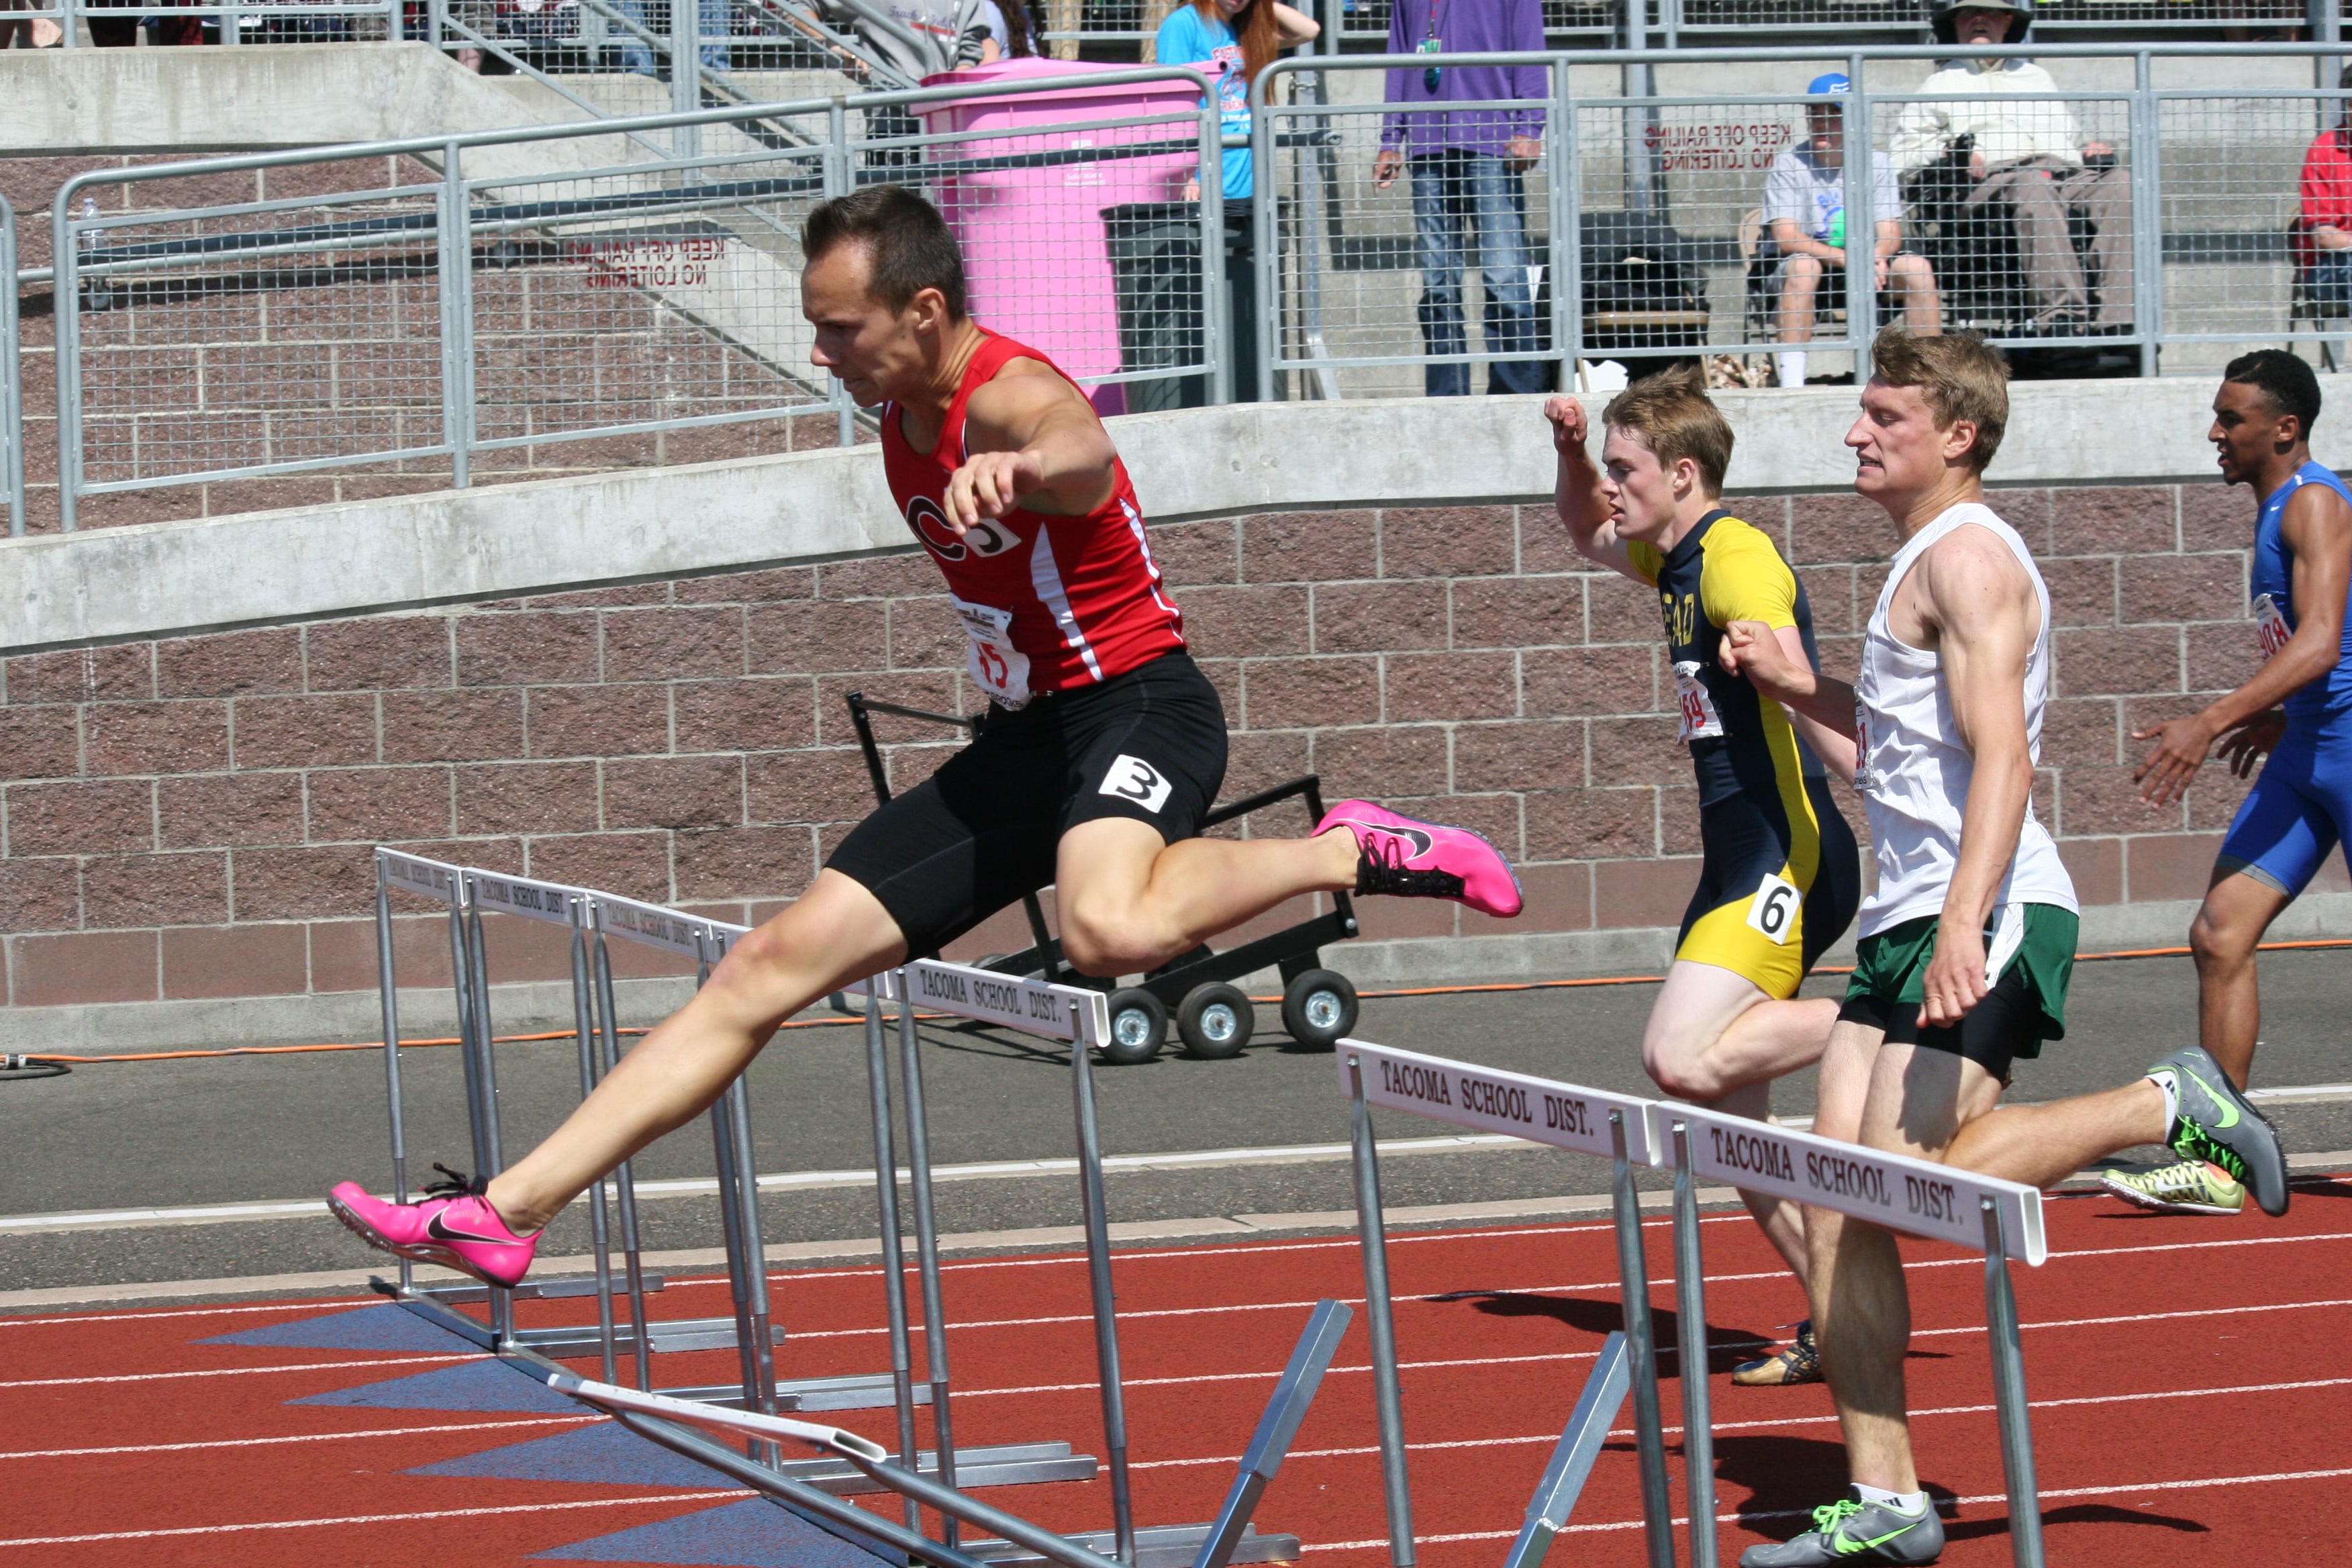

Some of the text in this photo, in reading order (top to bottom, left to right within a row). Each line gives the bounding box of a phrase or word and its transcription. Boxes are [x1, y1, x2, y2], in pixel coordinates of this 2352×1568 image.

[1115, 761, 1159, 800] 3
[481, 878, 510, 903] TACOMA
[513, 885, 542, 910] SCHOOL
[1761, 886, 1793, 934] 6
[920, 969, 1062, 1023] TACOMA SCHOOL DIST.
[1381, 1060, 1595, 1136] TACOMA SCHOOL DIST.
[1711, 1127, 1963, 1226] TACOMA SCHOOL DIST.
